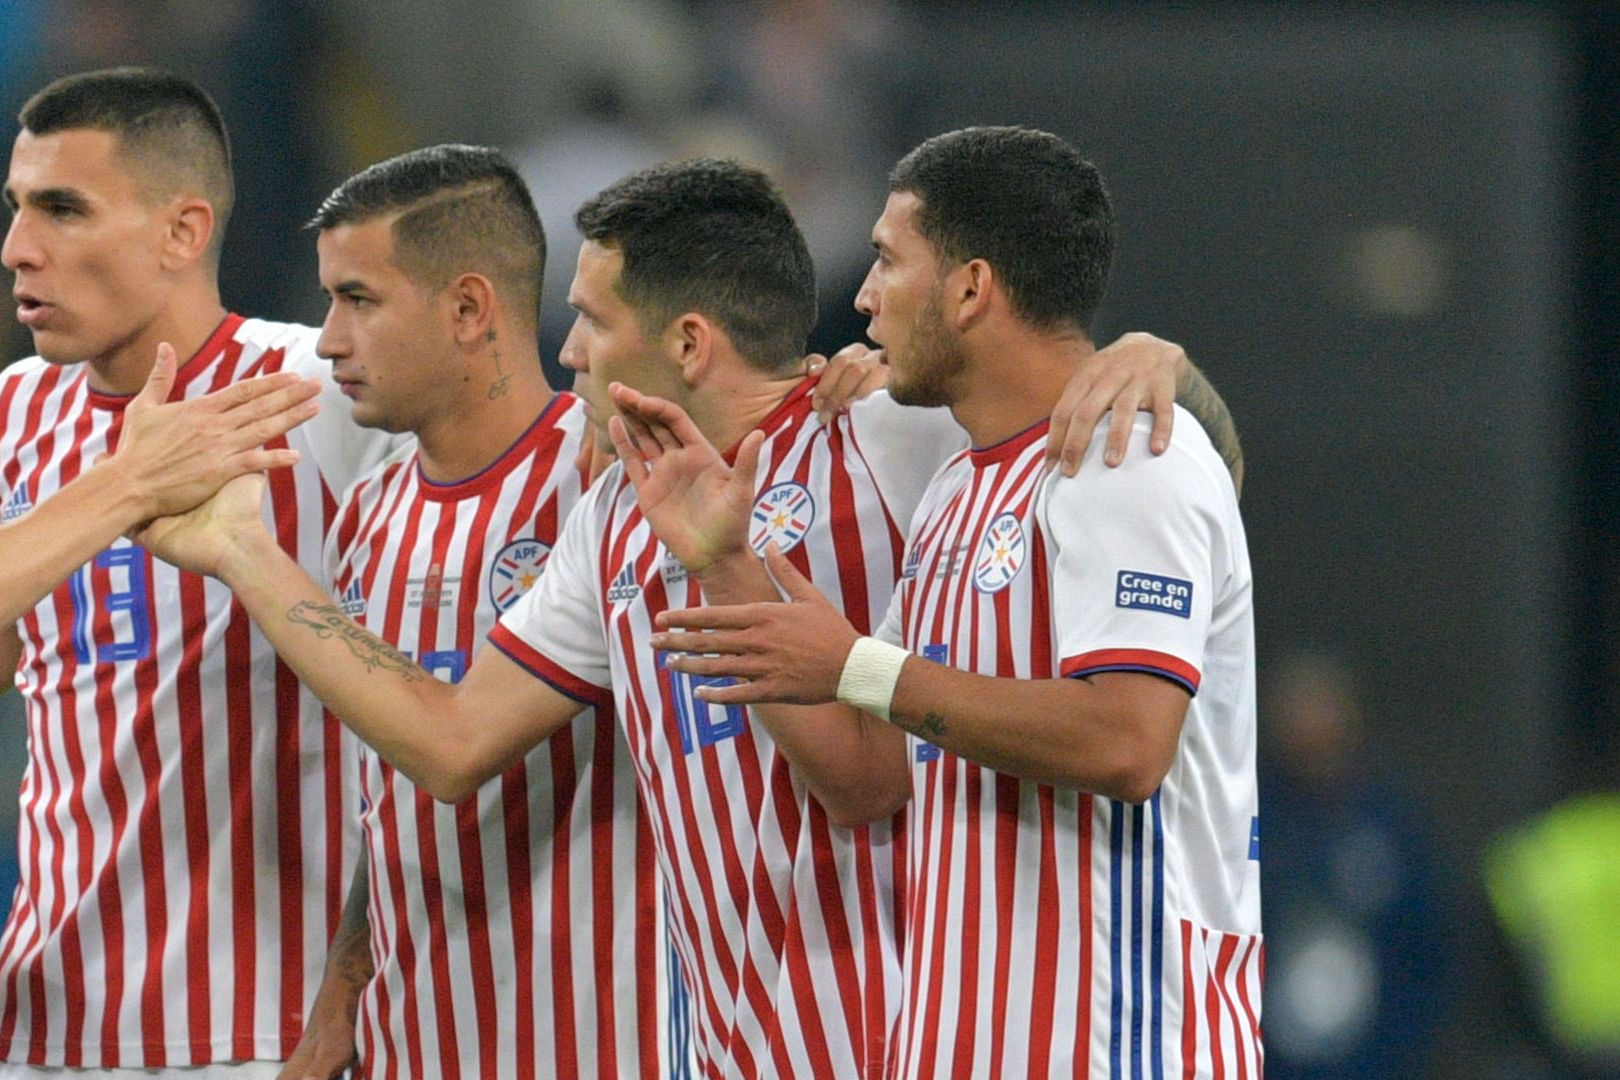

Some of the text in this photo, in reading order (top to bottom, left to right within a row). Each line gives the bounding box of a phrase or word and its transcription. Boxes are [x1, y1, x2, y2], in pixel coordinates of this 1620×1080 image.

[770, 487, 794, 503] APF
[513, 546, 538, 561] APF
[1121, 574, 1189, 598] Cree en
[68, 545, 151, 665] 13
[1119, 590, 1184, 611] grande
